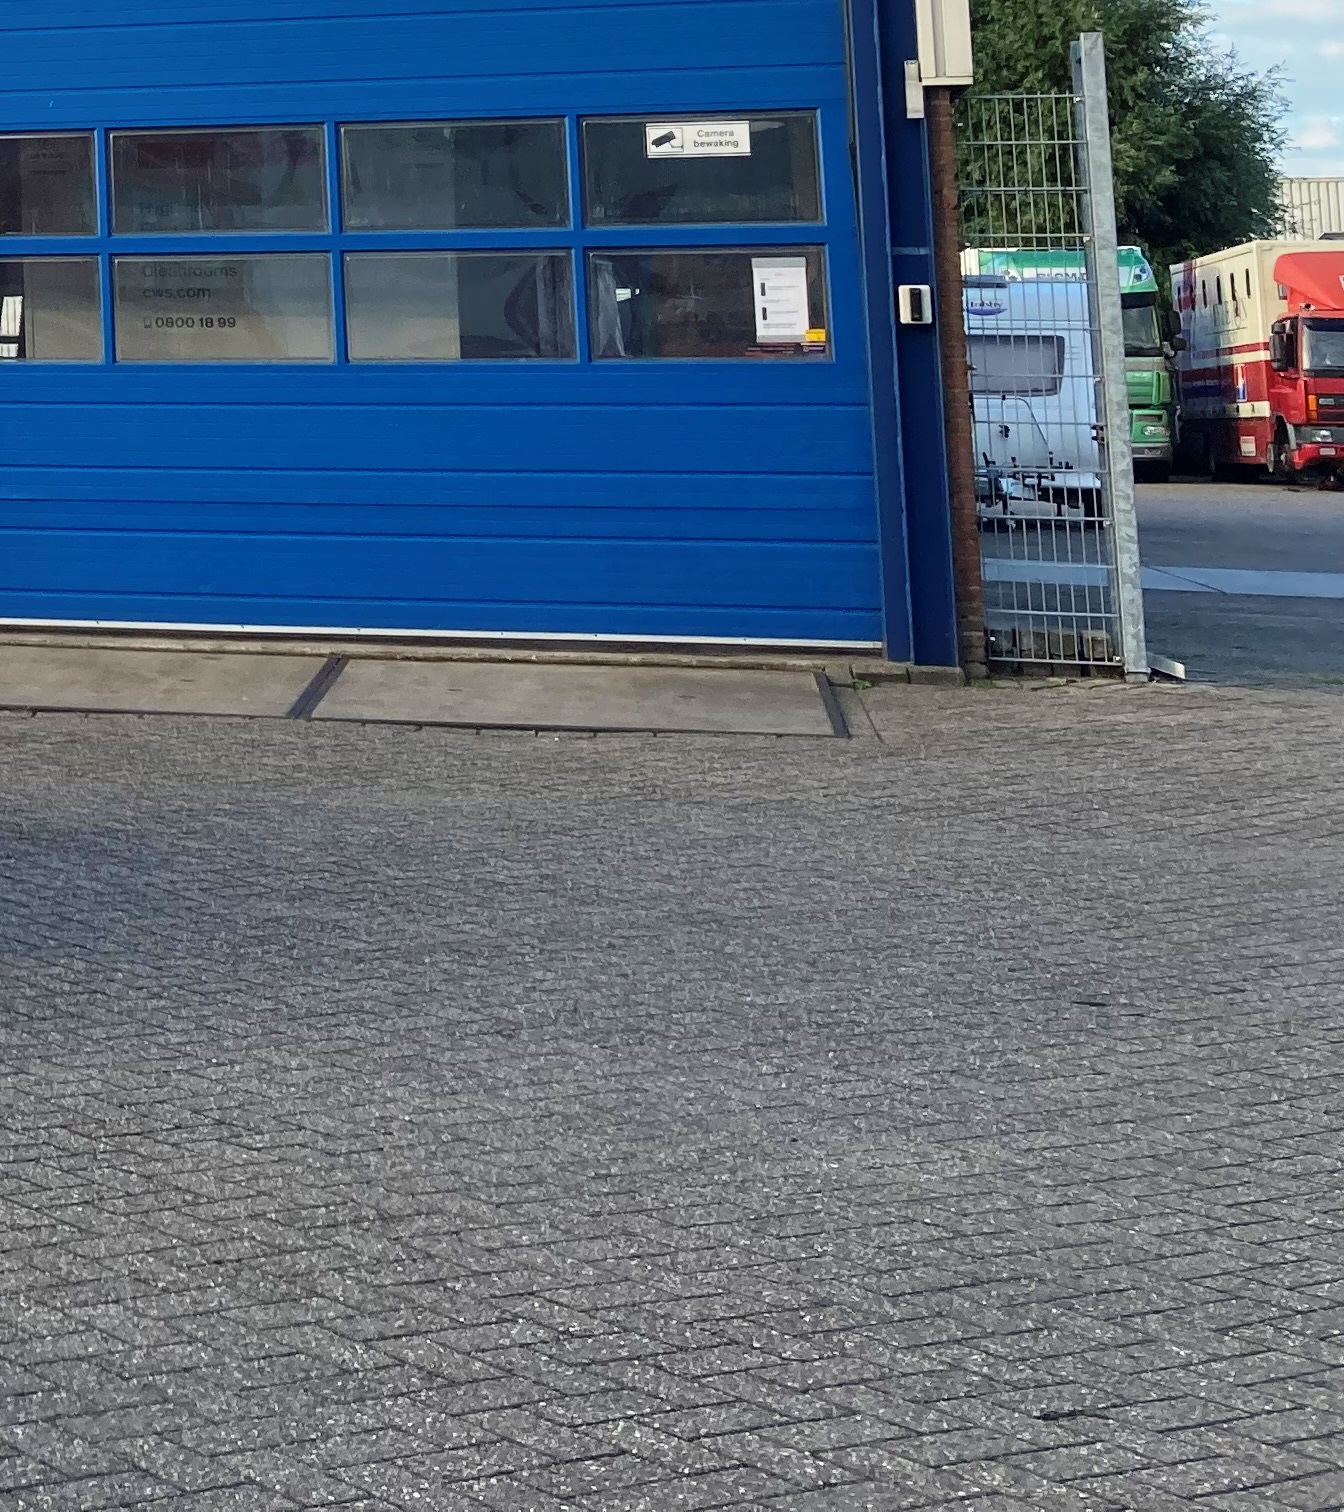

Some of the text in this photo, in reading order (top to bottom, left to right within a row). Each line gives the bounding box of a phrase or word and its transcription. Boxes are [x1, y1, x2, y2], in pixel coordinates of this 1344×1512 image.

[696, 129, 735, 138] Camera
[693, 139, 740, 149] bewaking
[155, 317, 236, 328] 0800 18 99
